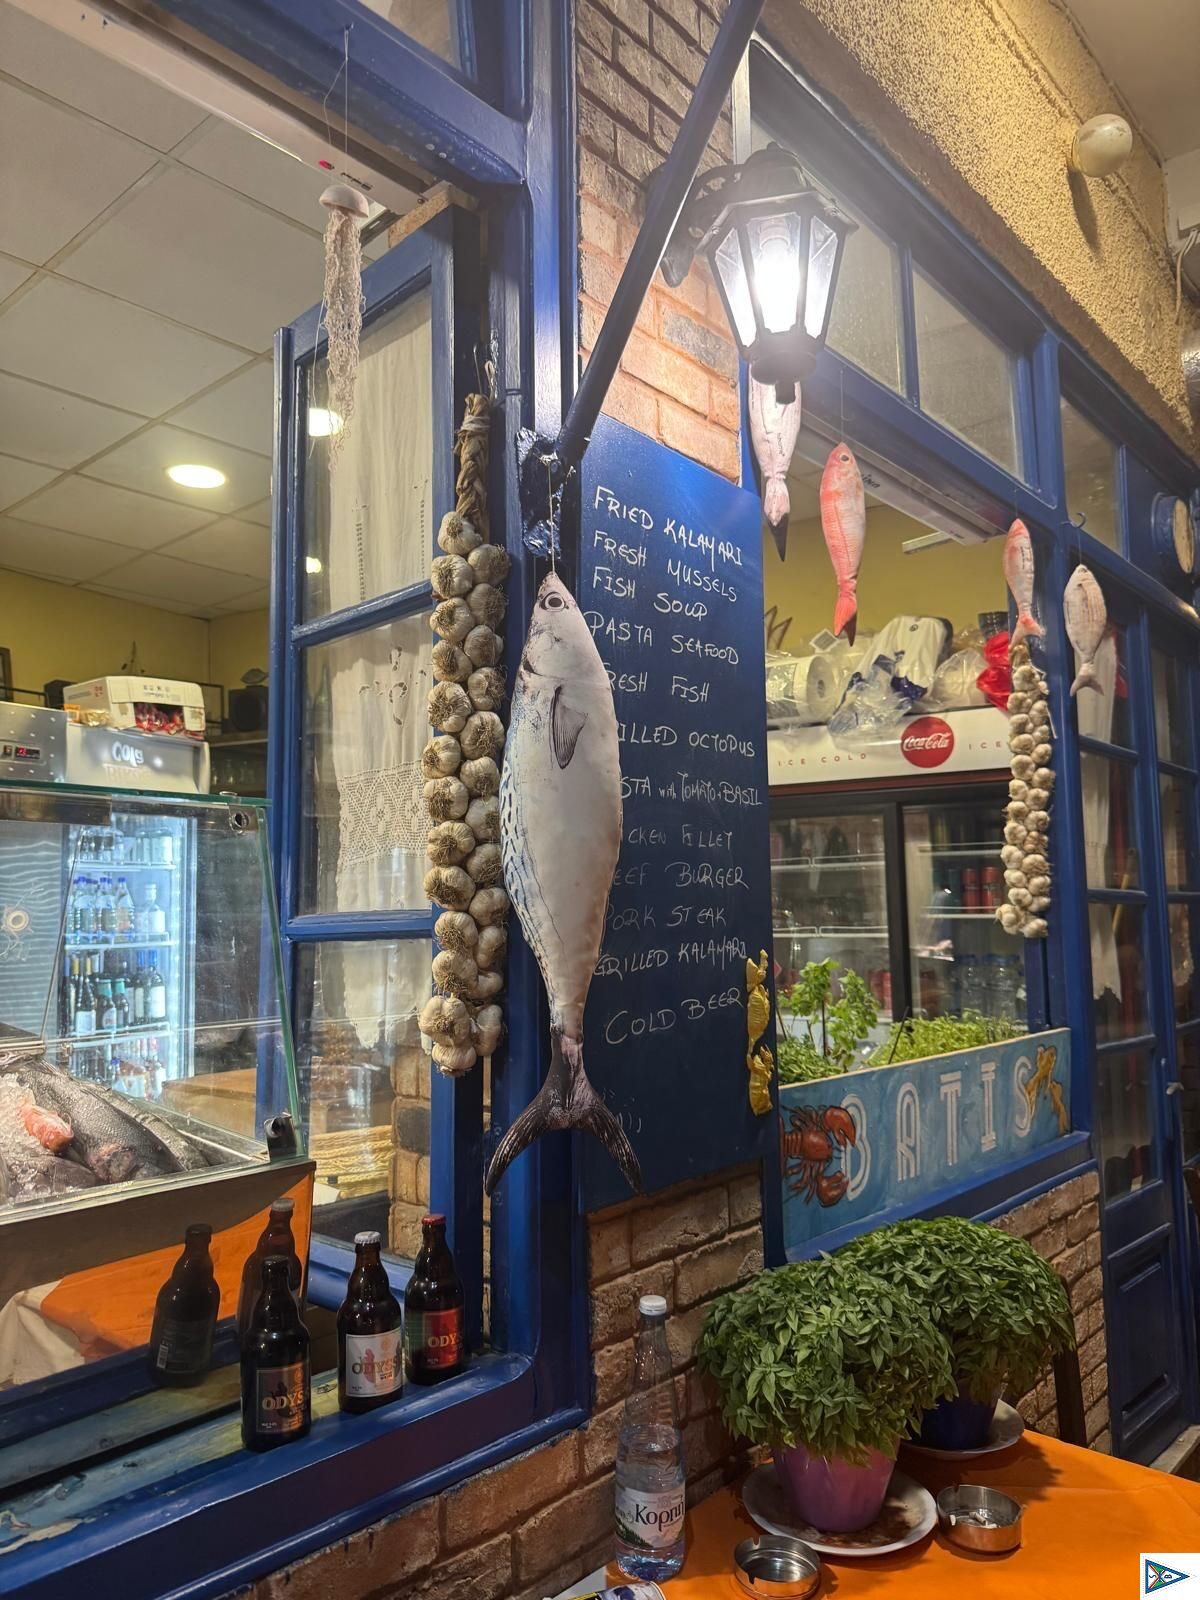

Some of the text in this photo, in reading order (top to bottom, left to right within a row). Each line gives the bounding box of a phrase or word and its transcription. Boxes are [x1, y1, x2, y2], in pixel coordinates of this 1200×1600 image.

[594, 485, 742, 572] FRIED KALAMARI
[593, 531, 737, 602] FRESH MUSSELS
[593, 566, 708, 622] FISH SOUP
[583, 611, 739, 665] PASTA SEAFOOD
[603, 662, 710, 703] RESH FISH
[618, 722, 755, 757] ILLED OCTOPUS
[903, 731, 952, 752] Coca-Cola
[778, 752, 868, 767] ICE COLD
[620, 776, 651, 799] STA
[658, 781, 677, 800] with
[628, 828, 667, 845] CKEN
[613, 861, 750, 889] EEF BURGER
[666, 905, 727, 928] STEAK
[593, 936, 748, 981] GRILLED KALAMARI
[605, 987, 744, 1045] COLD BEER
